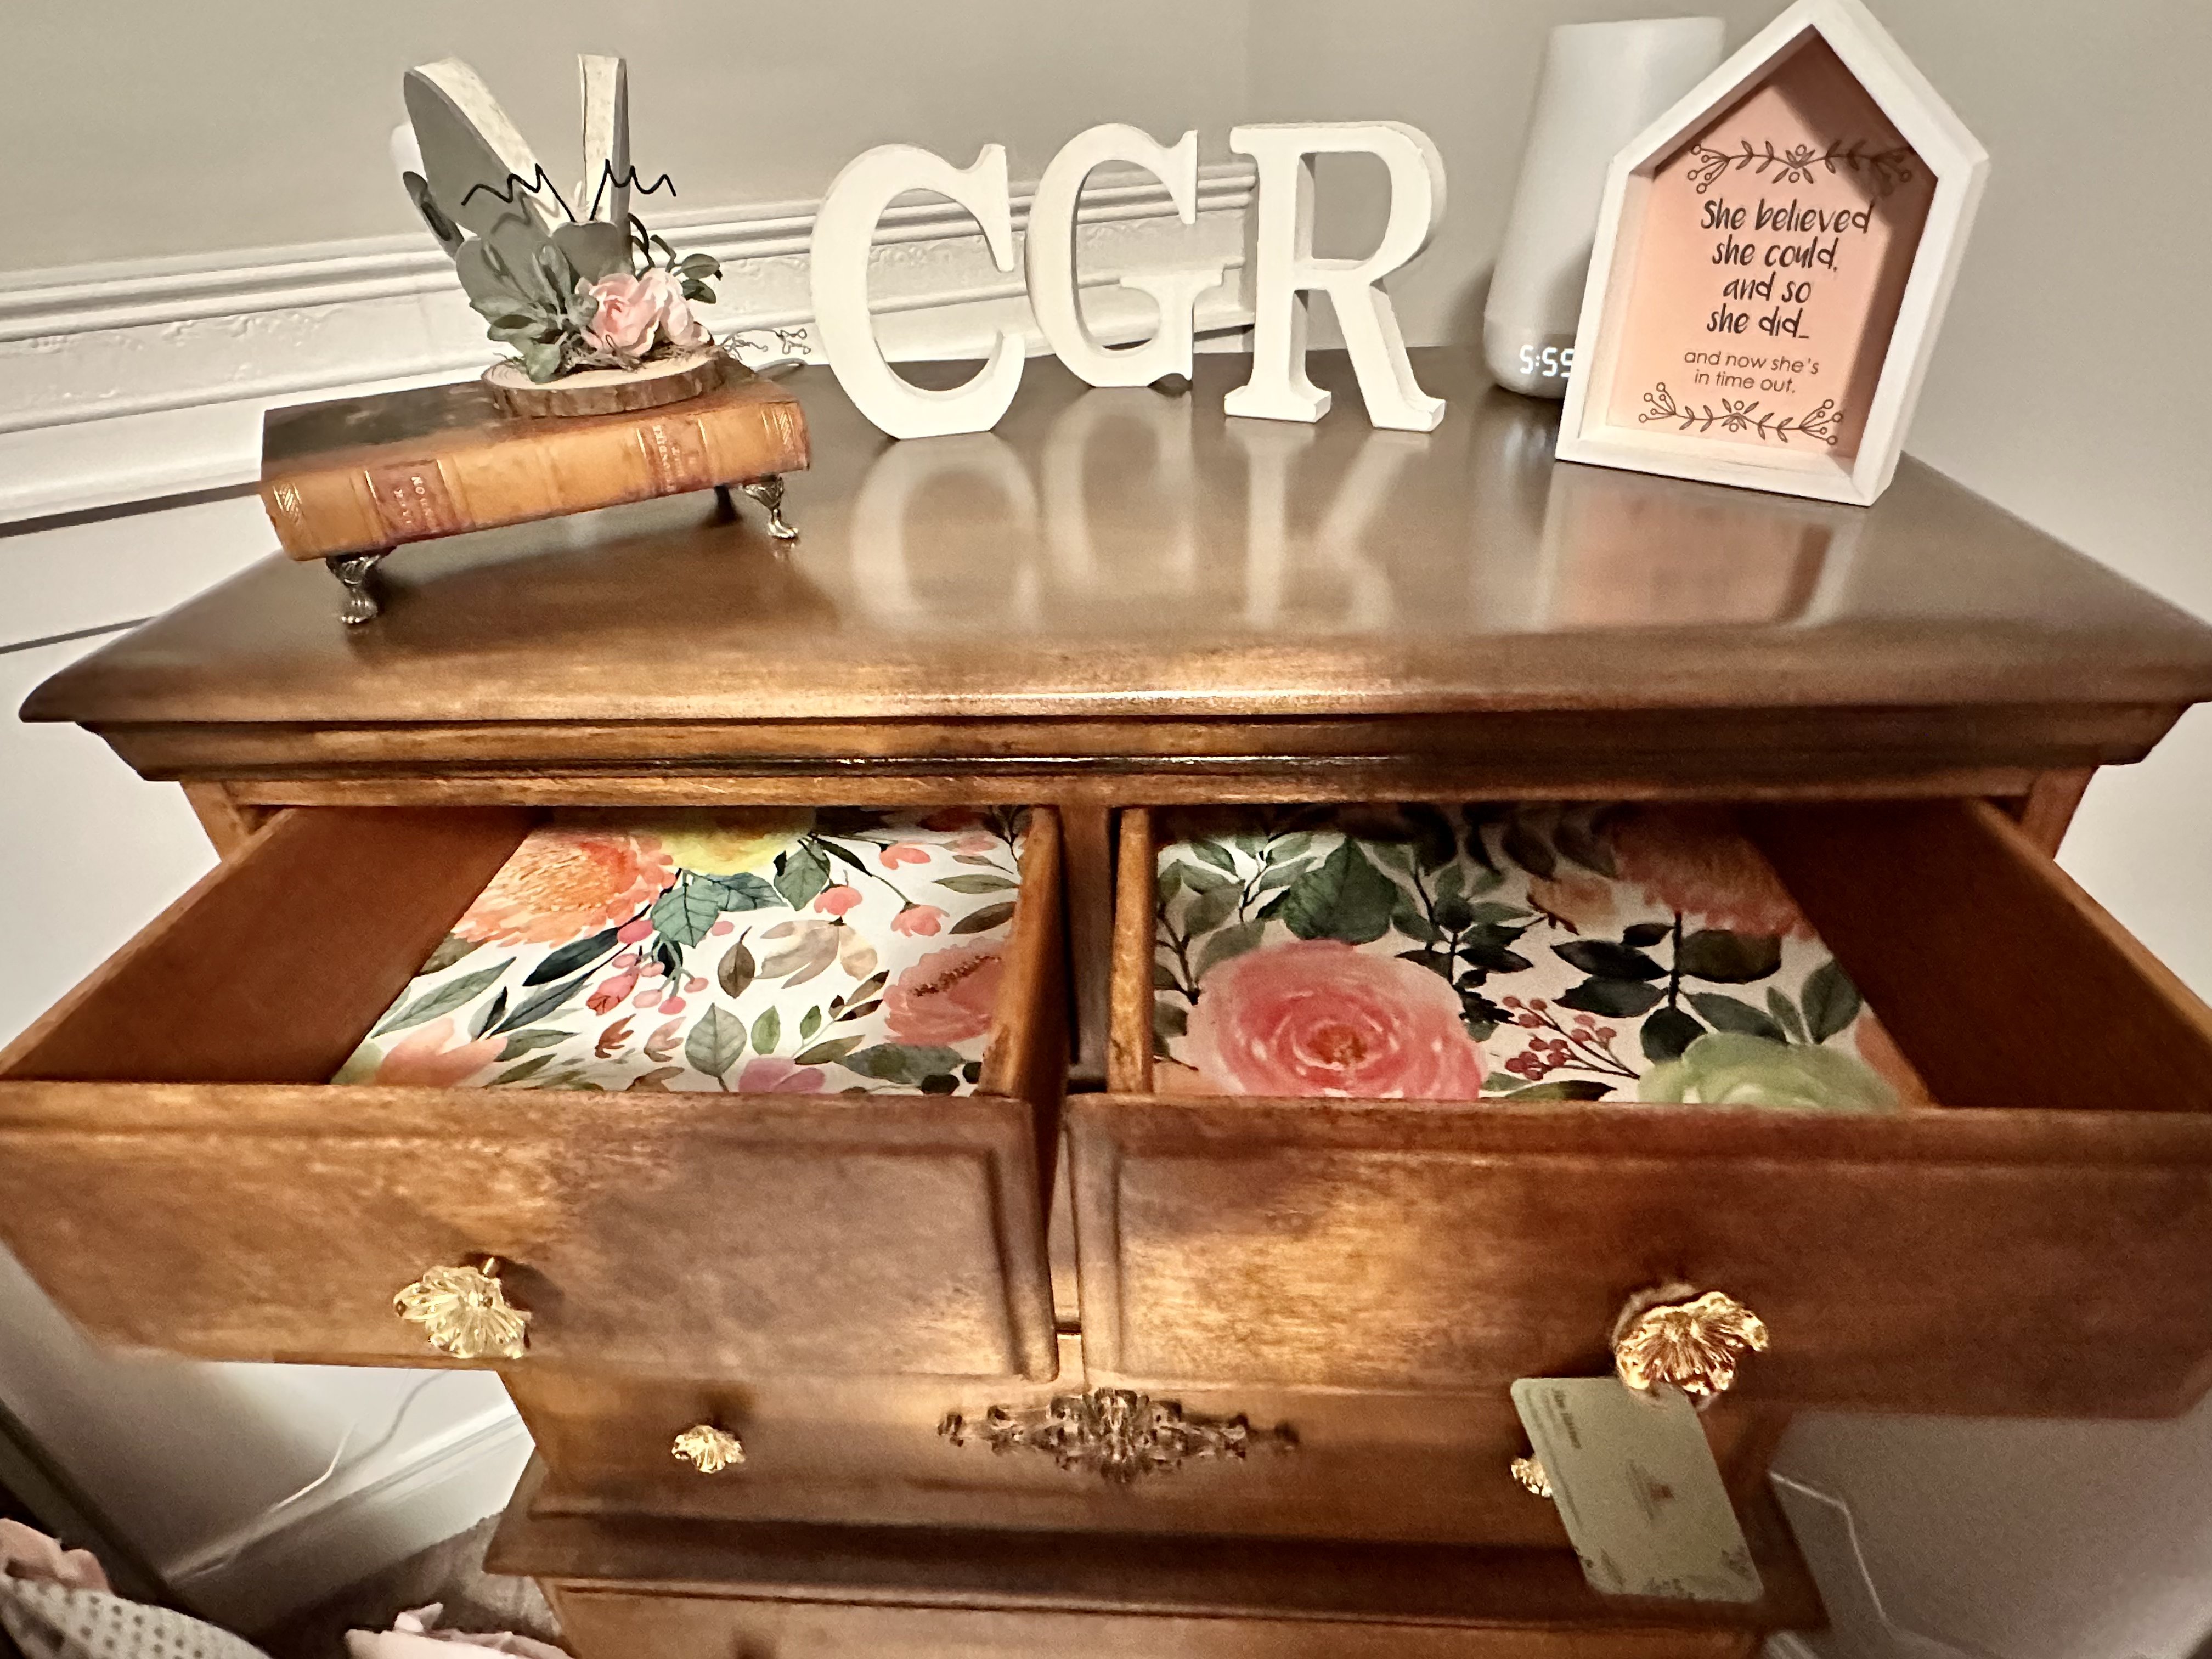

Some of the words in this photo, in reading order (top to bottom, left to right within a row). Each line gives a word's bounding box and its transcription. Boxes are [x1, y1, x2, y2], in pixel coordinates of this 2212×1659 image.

[1701, 198, 1746, 229] She
[1756, 198, 1874, 234] believed
[1712, 234, 1756, 266] she
[1723, 271, 1776, 301] and
[1781, 281, 1811, 303] so
[1706, 303, 1750, 334] she
[1684, 351, 1721, 365] and
[1725, 355, 1766, 369] now
[1770, 356, 1819, 374] she's
[1694, 369, 1709, 385] in
[1716, 371, 1755, 389] time
[1760, 377, 1796, 394] out.
